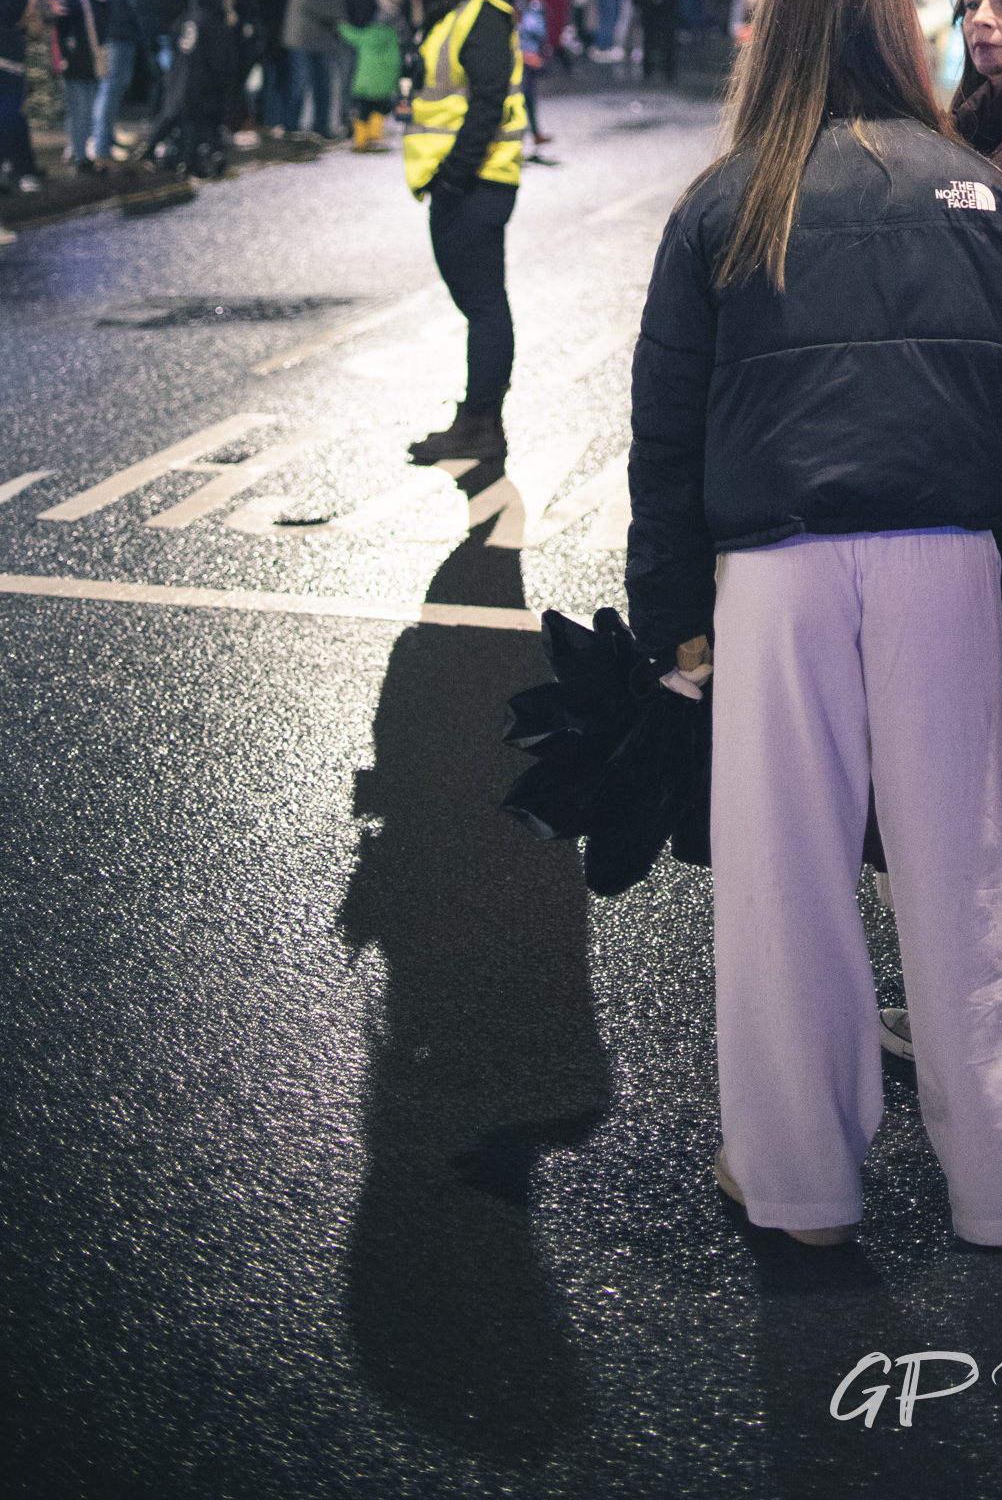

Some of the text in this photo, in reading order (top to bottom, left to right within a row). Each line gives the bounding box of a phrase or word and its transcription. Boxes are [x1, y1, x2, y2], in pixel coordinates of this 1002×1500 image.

[949, 180, 974, 191] THE
[934, 188, 976, 200] NORTH
[947, 198, 977, 209] FACE
